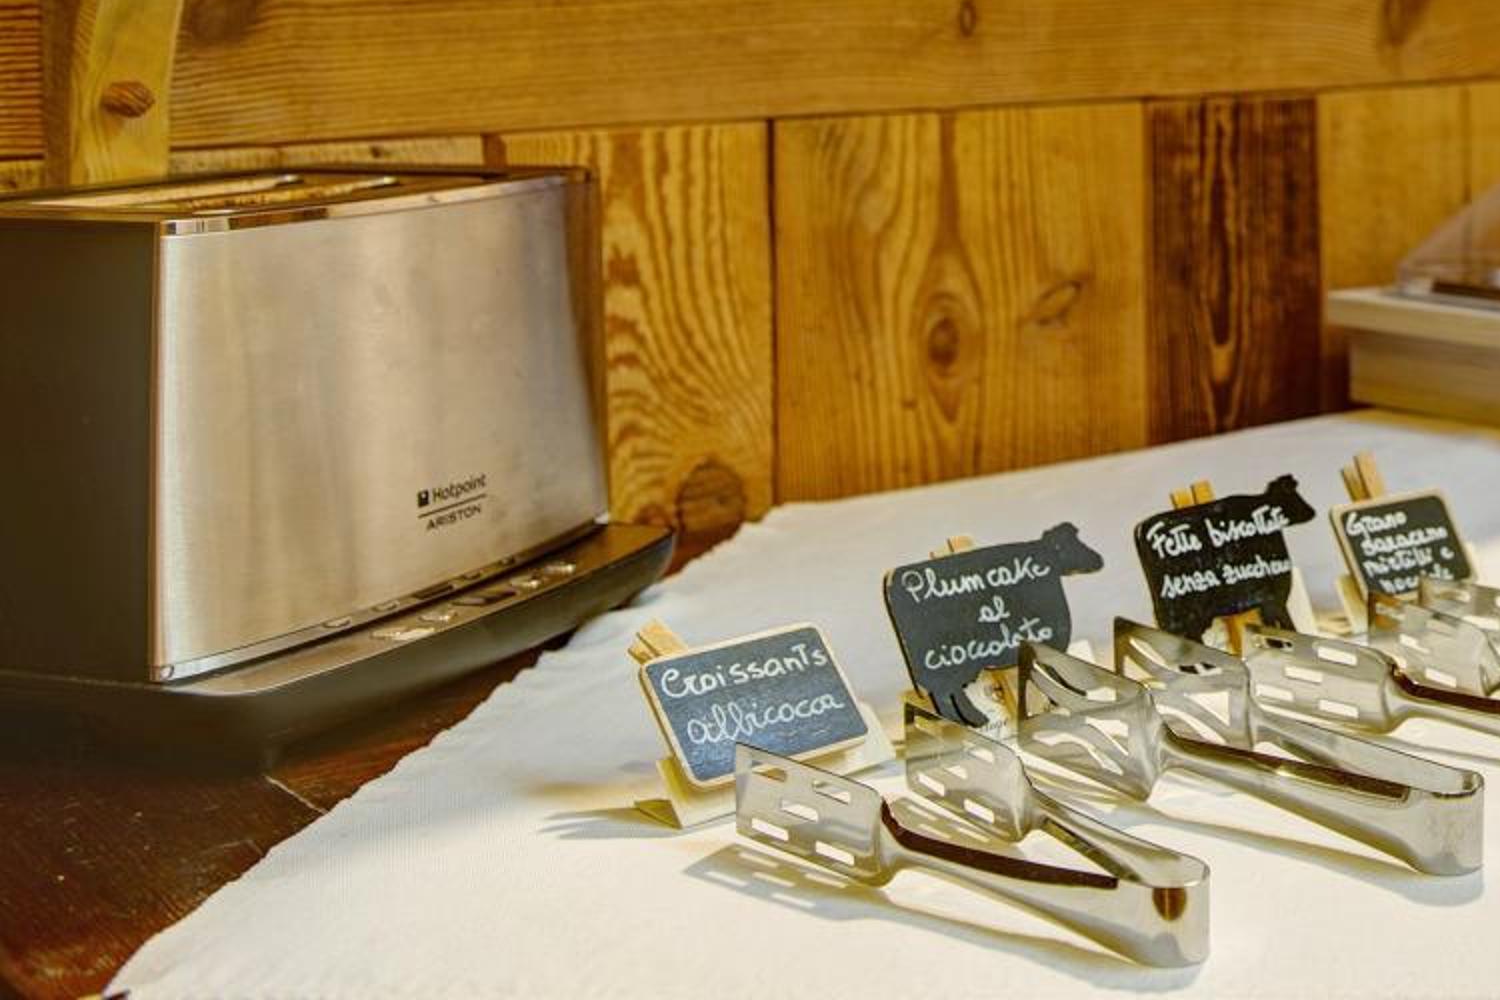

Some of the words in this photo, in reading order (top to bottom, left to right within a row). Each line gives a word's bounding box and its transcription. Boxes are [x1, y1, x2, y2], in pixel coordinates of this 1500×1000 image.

[432, 473, 487, 503] Hotpoint
[426, 504, 482, 531] ARISTON
[1345, 511, 1408, 539] Grano
[1146, 520, 1203, 560] Fette
[1160, 570, 1221, 600] senza
[978, 595, 1011, 624] al
[686, 692, 846, 746] albicocca
